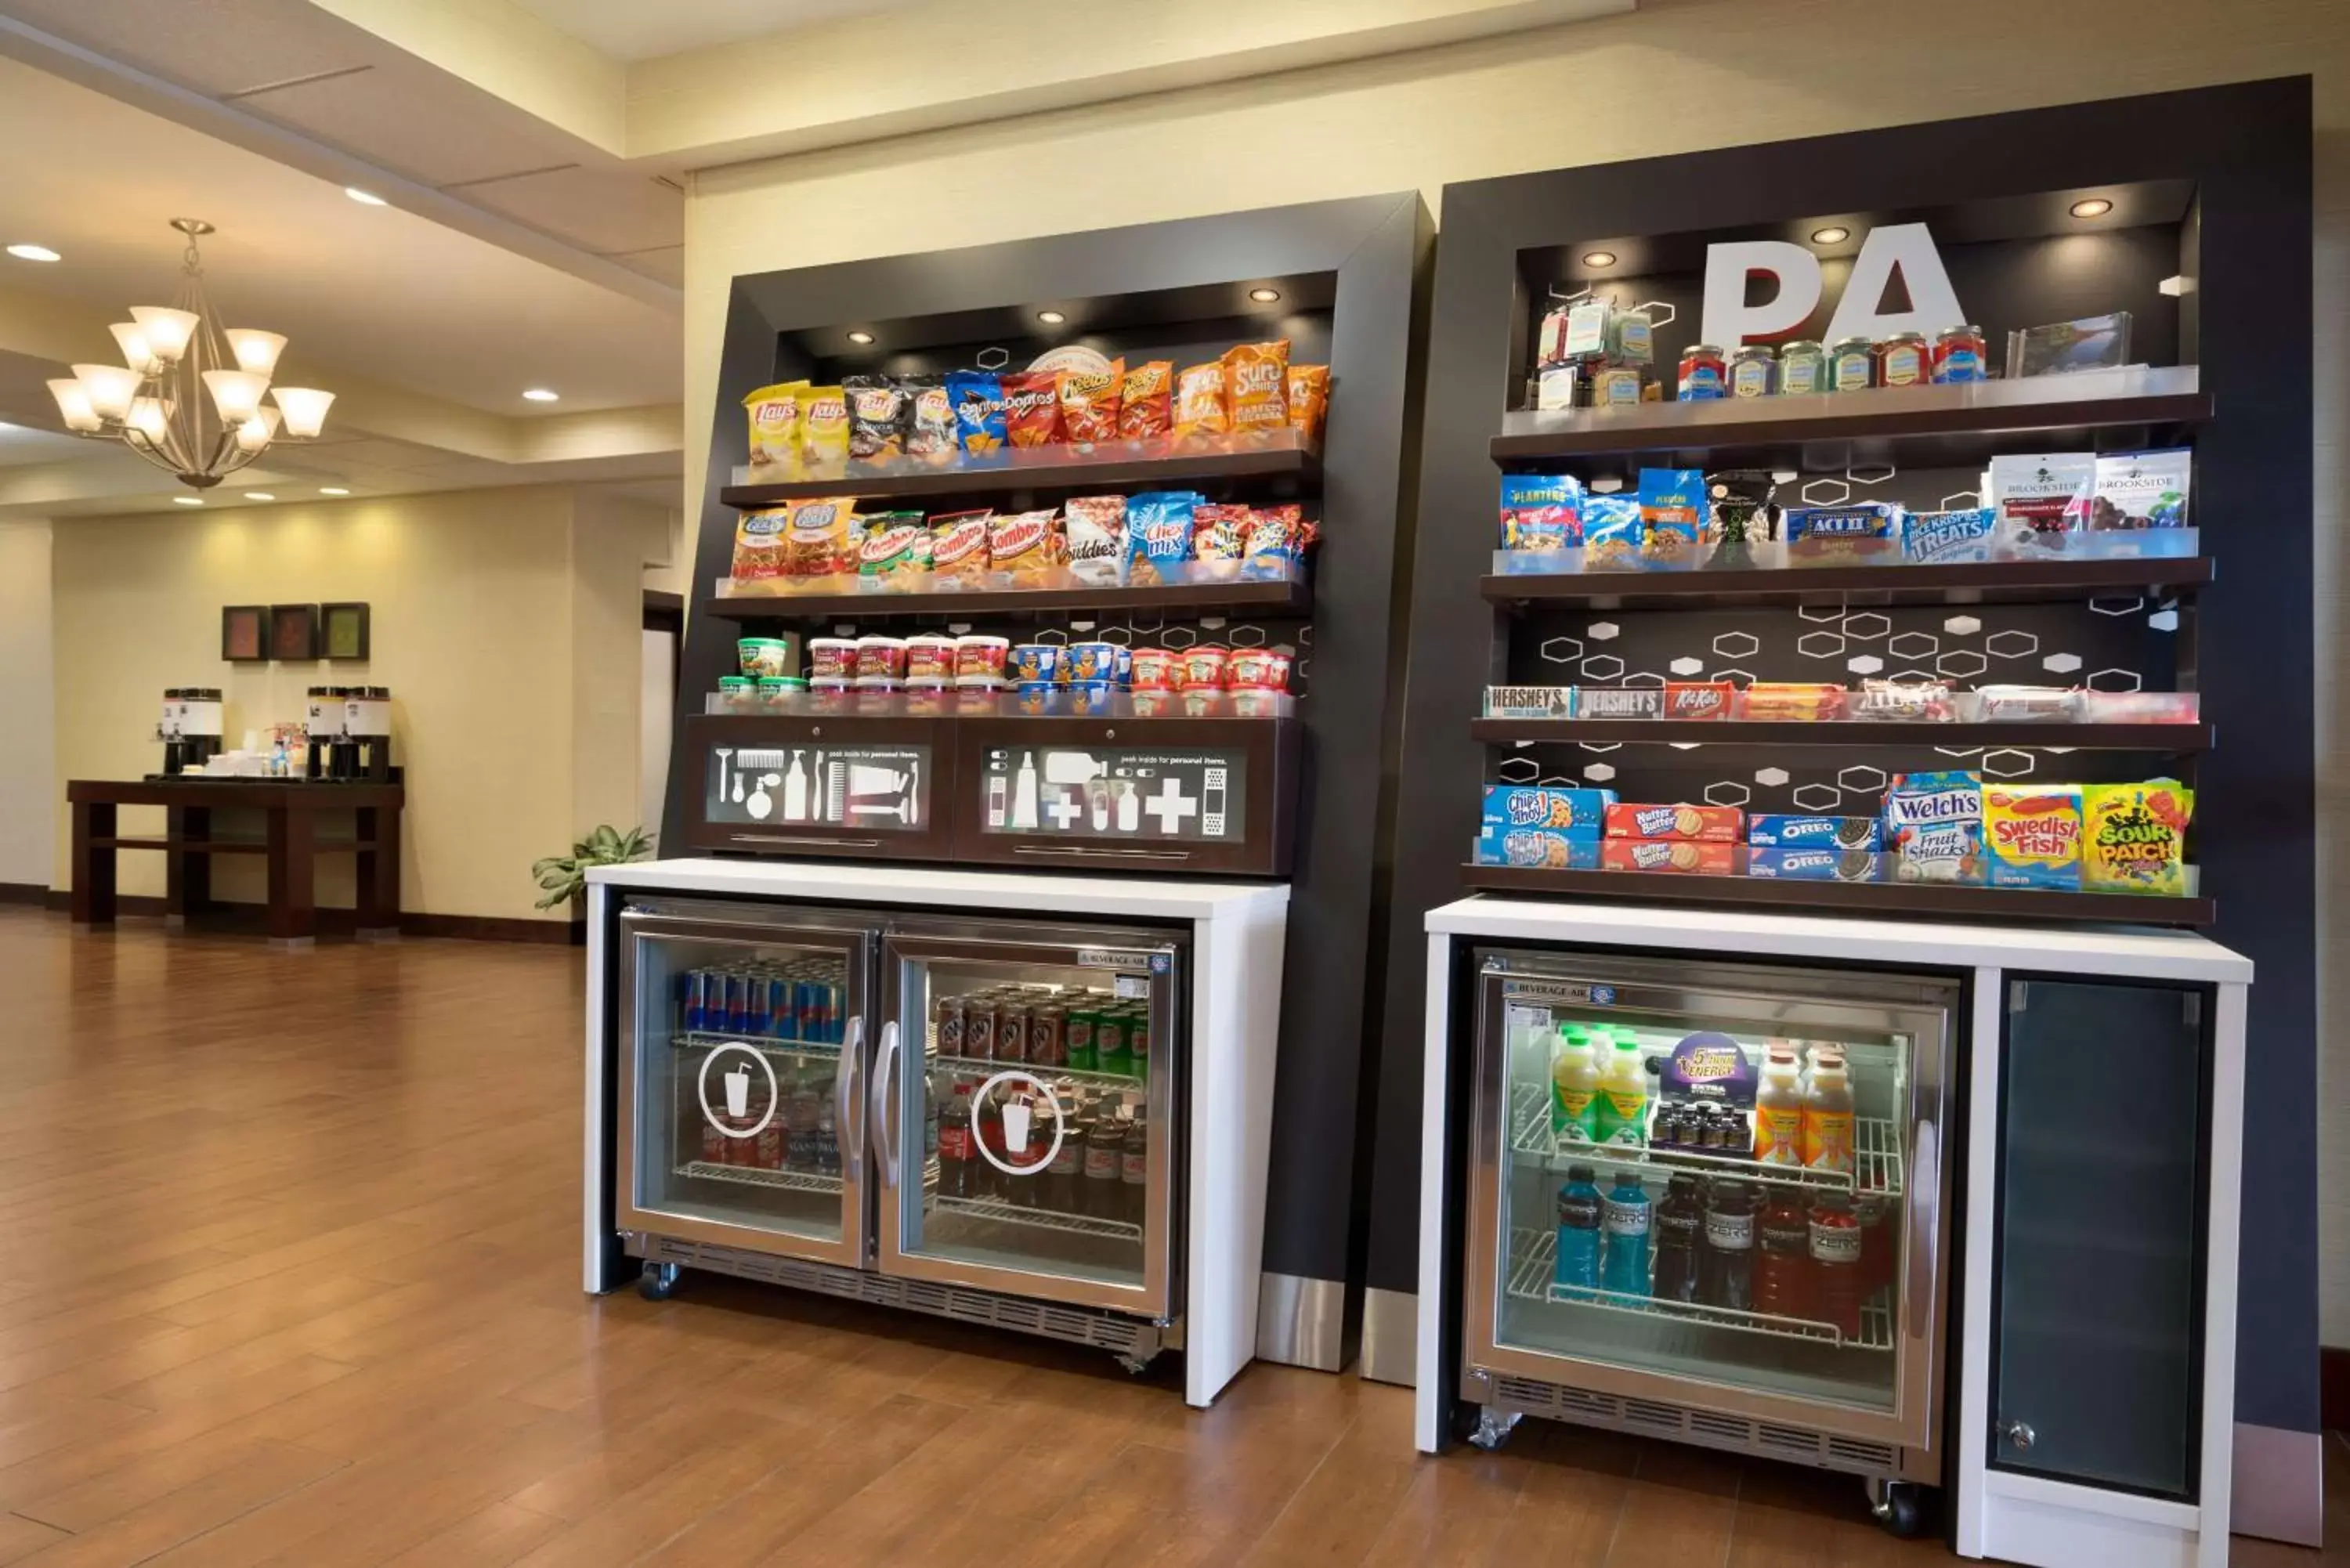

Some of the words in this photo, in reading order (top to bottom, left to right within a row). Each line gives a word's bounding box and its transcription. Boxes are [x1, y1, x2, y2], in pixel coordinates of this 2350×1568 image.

[1701, 222, 1969, 352] PA
[1235, 359, 1282, 396] Sun
[809, 399, 848, 419] Lay's
[1005, 389, 1055, 410] Doritos
[757, 401, 798, 421] Lay's
[2007, 482, 2081, 494] BROOKSIDE
[2098, 477, 2175, 490] BROOKSIDE
[1512, 488, 1567, 504] PLANTERS
[1813, 518, 1843, 533] ACT
[1907, 522, 1932, 542] RICE
[1930, 511, 1982, 533] KRISPIES
[932, 525, 982, 555] Combos
[1911, 522, 1984, 562] TREATS
[1492, 688, 1564, 708] HERSHEY'S
[1582, 690, 1658, 713] HERSHEY'S
[1120, 755, 1137, 764] peek
[1170, 757, 1202, 765] personal
[1204, 757, 1227, 765] items.
[1507, 792, 1540, 811] Chips
[1897, 793, 1979, 818] Welch's
[1635, 807, 1672, 825] Nutter
[1640, 816, 1677, 836] Butter
[1782, 822, 1834, 839] OREO
[2099, 824, 2170, 845] SOUR
[1920, 830, 1959, 847] Fruit
[2015, 835, 2066, 857] Fish
[1632, 843, 1668, 861] Nutter
[1637, 851, 1673, 869] Butter
[1908, 844, 1967, 860] Snacks
[2100, 842, 2175, 863] PATCH
[1782, 854, 1834, 871] OREO
[1687, 1064, 1733, 1078] ENERGY
[1711, 1225, 1749, 1237] ZERO
